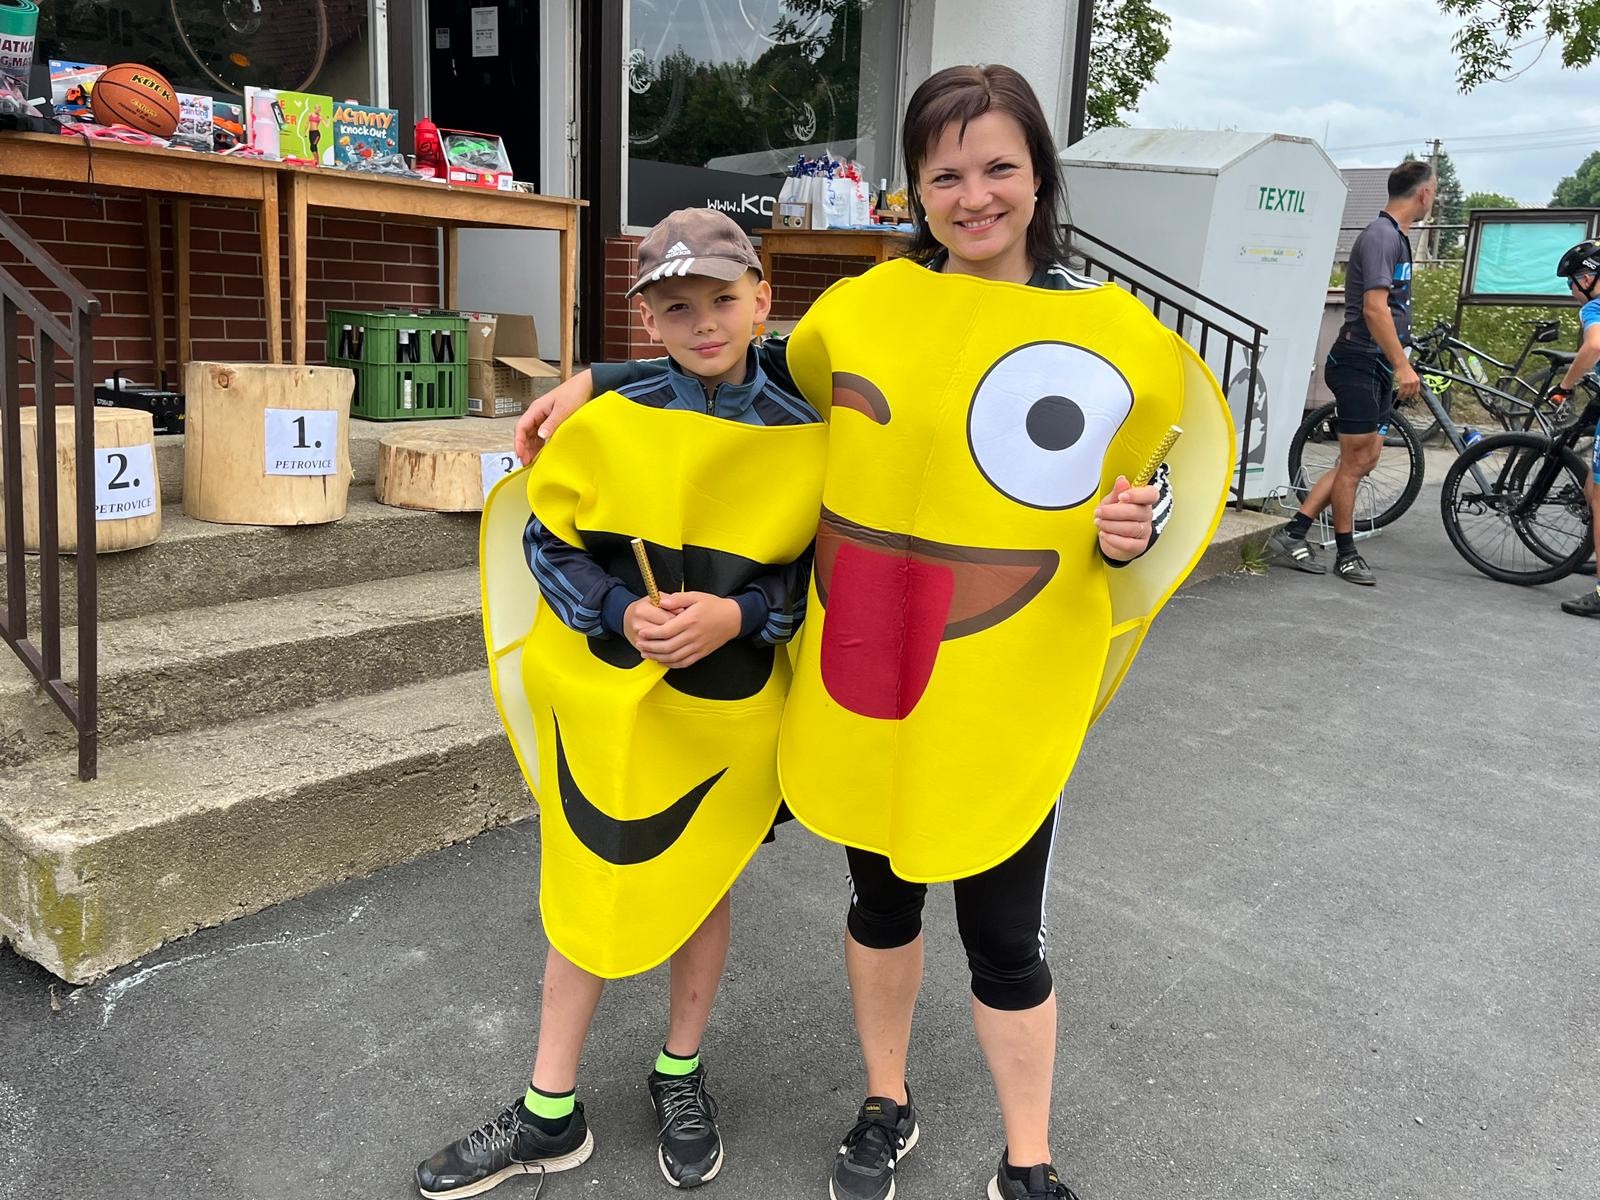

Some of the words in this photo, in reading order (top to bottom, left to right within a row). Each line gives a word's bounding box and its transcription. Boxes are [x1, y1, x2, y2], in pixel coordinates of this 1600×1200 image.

[333, 105, 393, 129] ACTIVITY
[1258, 186, 1305, 213] TEXTIL
[292, 415, 322, 449] 1.
[107, 453, 141, 490] 2.
[275, 459, 333, 470] PETROVICE
